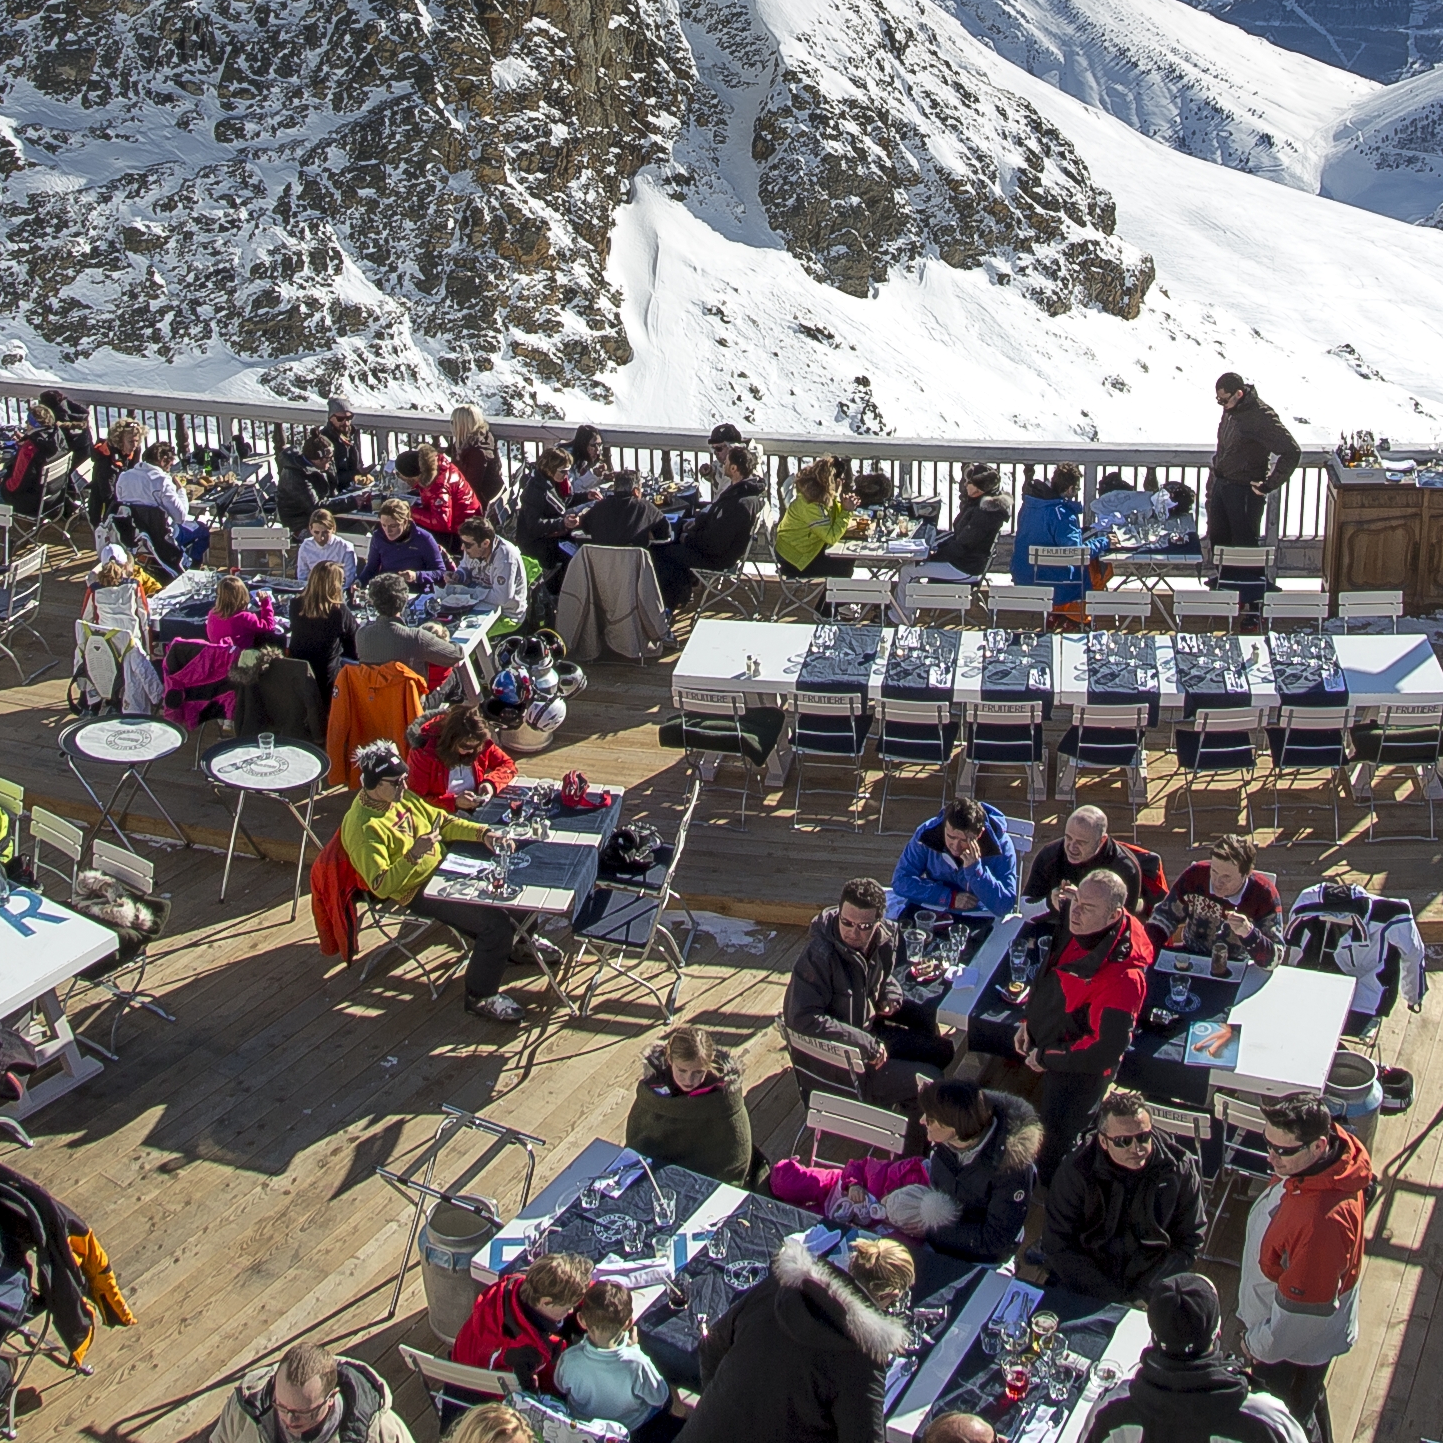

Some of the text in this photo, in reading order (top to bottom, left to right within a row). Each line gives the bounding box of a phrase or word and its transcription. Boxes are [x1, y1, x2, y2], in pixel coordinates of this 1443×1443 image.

[802, 693, 846, 704] FRUITIERE
[982, 703, 1027, 713] FRUITIERE
[1395, 705, 1440, 714] FRUITIERE
